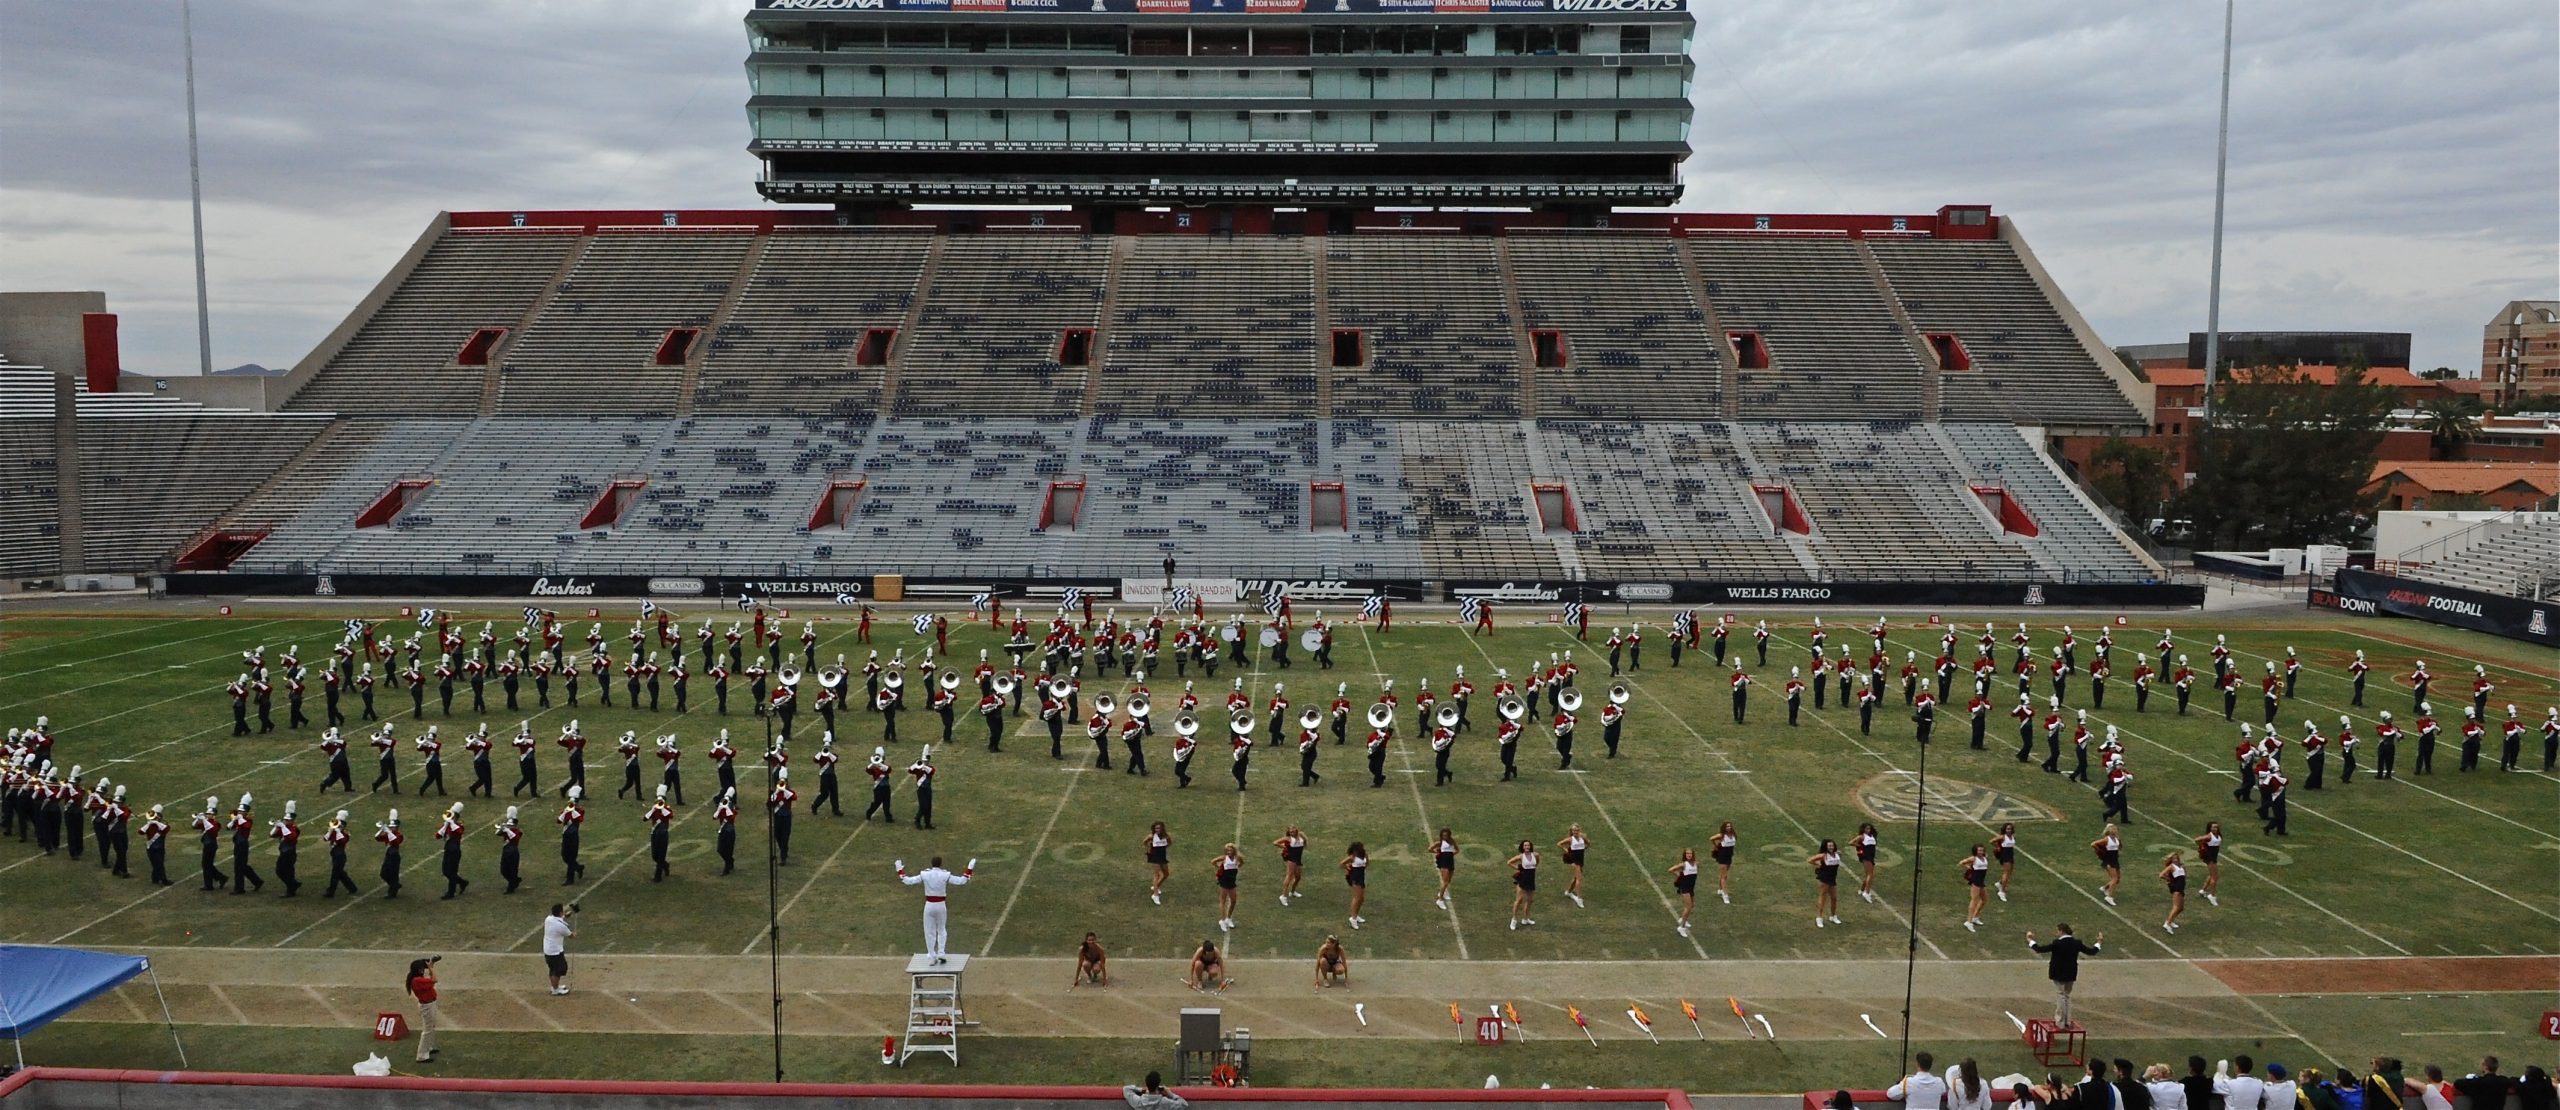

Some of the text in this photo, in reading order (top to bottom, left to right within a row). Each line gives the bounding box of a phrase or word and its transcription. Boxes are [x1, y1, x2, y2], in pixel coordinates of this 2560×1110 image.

[1553, 0, 1680, 10] WILDCATS
[514, 217, 524, 227] 17
[664, 217, 676, 226] 18
[1031, 217, 1044, 226] 20
[1178, 217, 1189, 227] 21
[1400, 218, 1412, 227] 22
[1596, 219, 1609, 228] 23
[1756, 221, 1769, 230] 24
[1893, 222, 1905, 231] 25
[530, 577, 595, 596] Bashas'
[758, 582, 862, 593] WELLS FARGO
[1125, 585, 1159, 595] UNIVERSITY
[1200, 585, 1219, 595] BAND
[1220, 585, 1233, 595] DAY
[1727, 588, 1831, 599] WELLS FARGO
[2340, 597, 2376, 614] DOWN
[2386, 588, 2483, 617] ARIZONA FOOTBALL
[976, 841, 1114, 864] 50
[1362, 843, 1505, 867] 40
[377, 1017, 396, 1037] 40
[1480, 1021, 1499, 1041] 40
